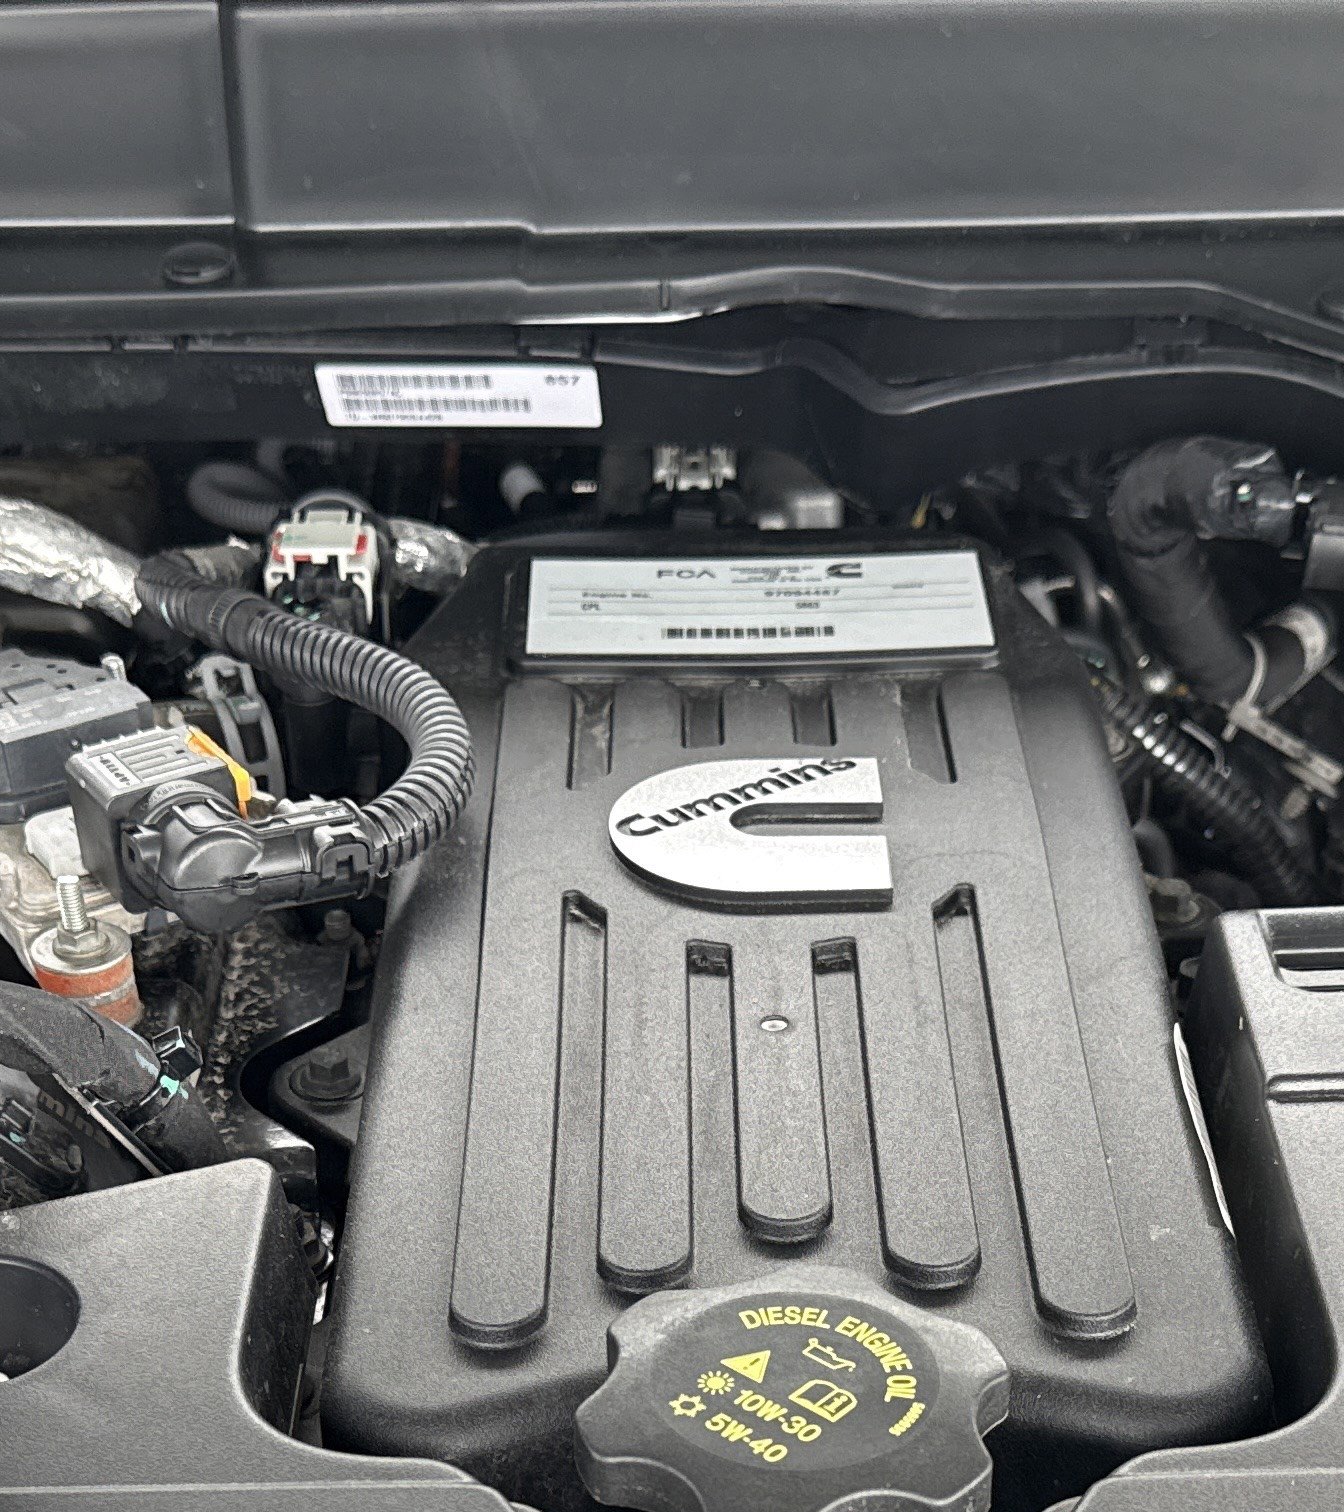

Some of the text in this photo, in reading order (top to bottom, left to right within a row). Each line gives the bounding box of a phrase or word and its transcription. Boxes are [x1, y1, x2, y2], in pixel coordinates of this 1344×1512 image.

[616, 759, 857, 837] Cummins
[738, 1306, 917, 1403] DIESEL ENGINE OIL
[705, 1412, 789, 1462] 5W-40
[733, 1389, 822, 1442] 10W-30
